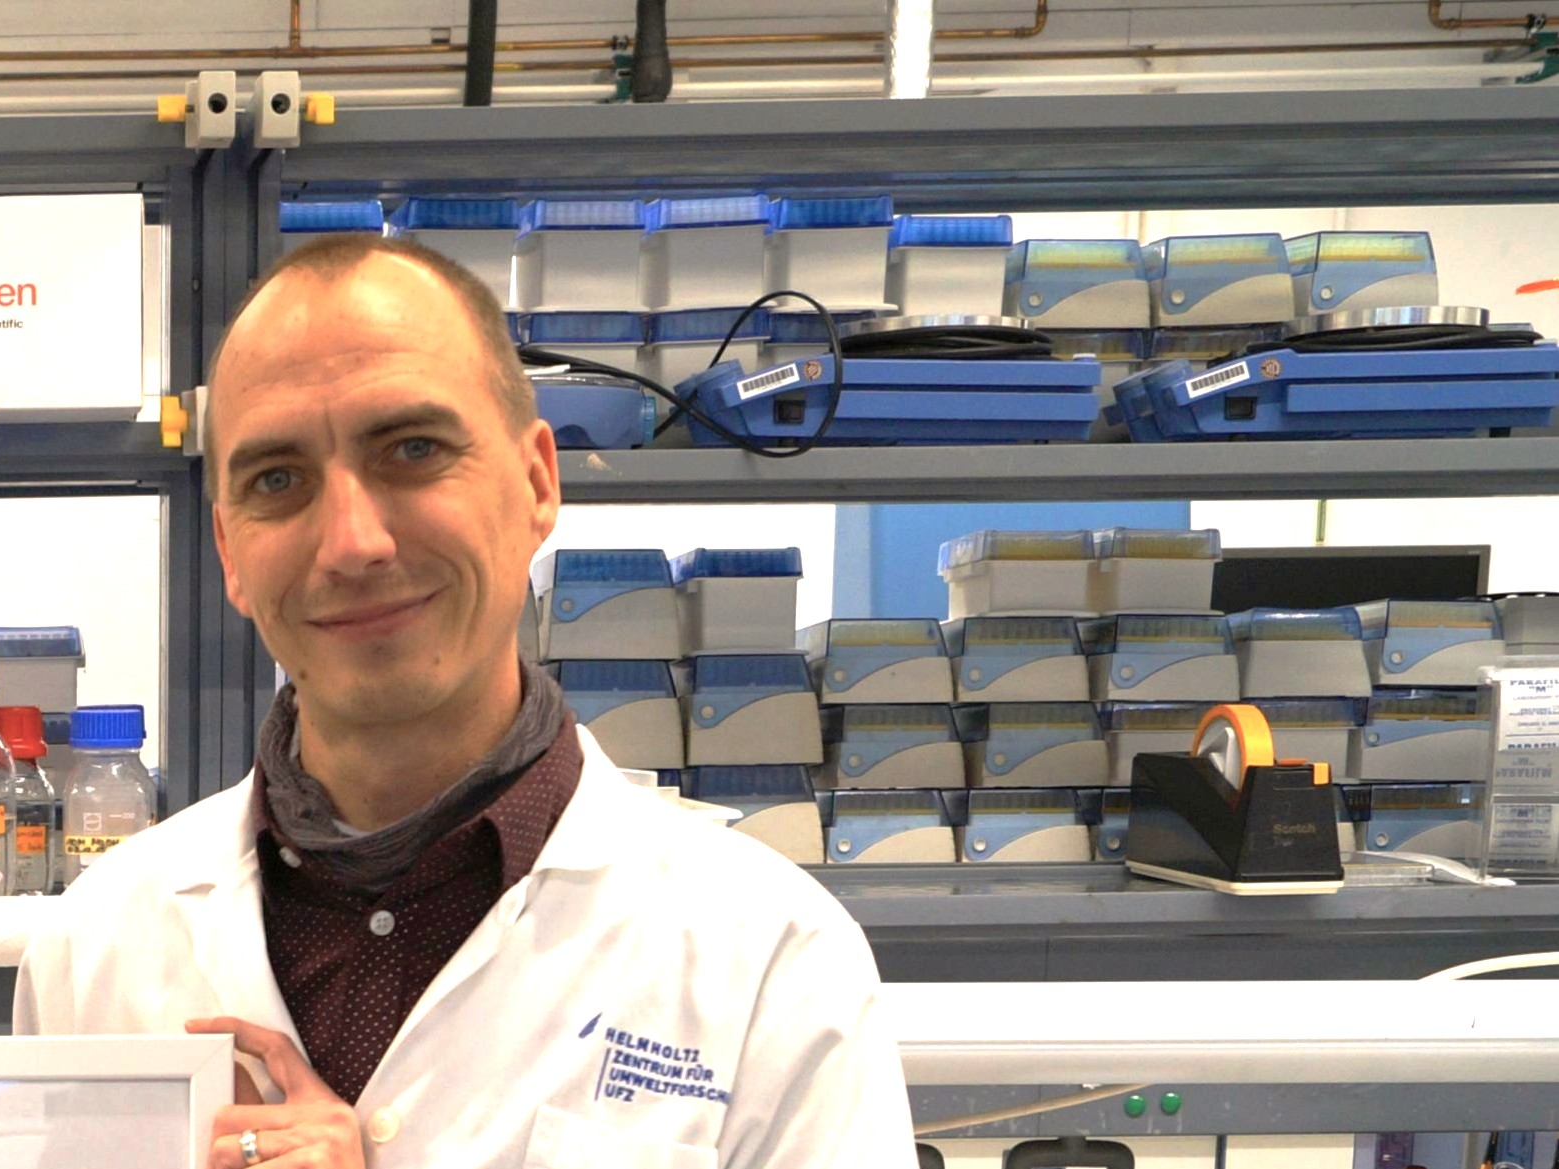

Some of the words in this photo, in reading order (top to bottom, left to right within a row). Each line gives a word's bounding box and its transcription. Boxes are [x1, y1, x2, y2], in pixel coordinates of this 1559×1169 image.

[1272, 823, 1316, 834] Scotch
[604, 1027, 700, 1063] HELMHOLTZ
[612, 1050, 683, 1080] ZENTRUM
[685, 1063, 714, 1082] FÜR
[604, 1083, 635, 1102] UFZ
